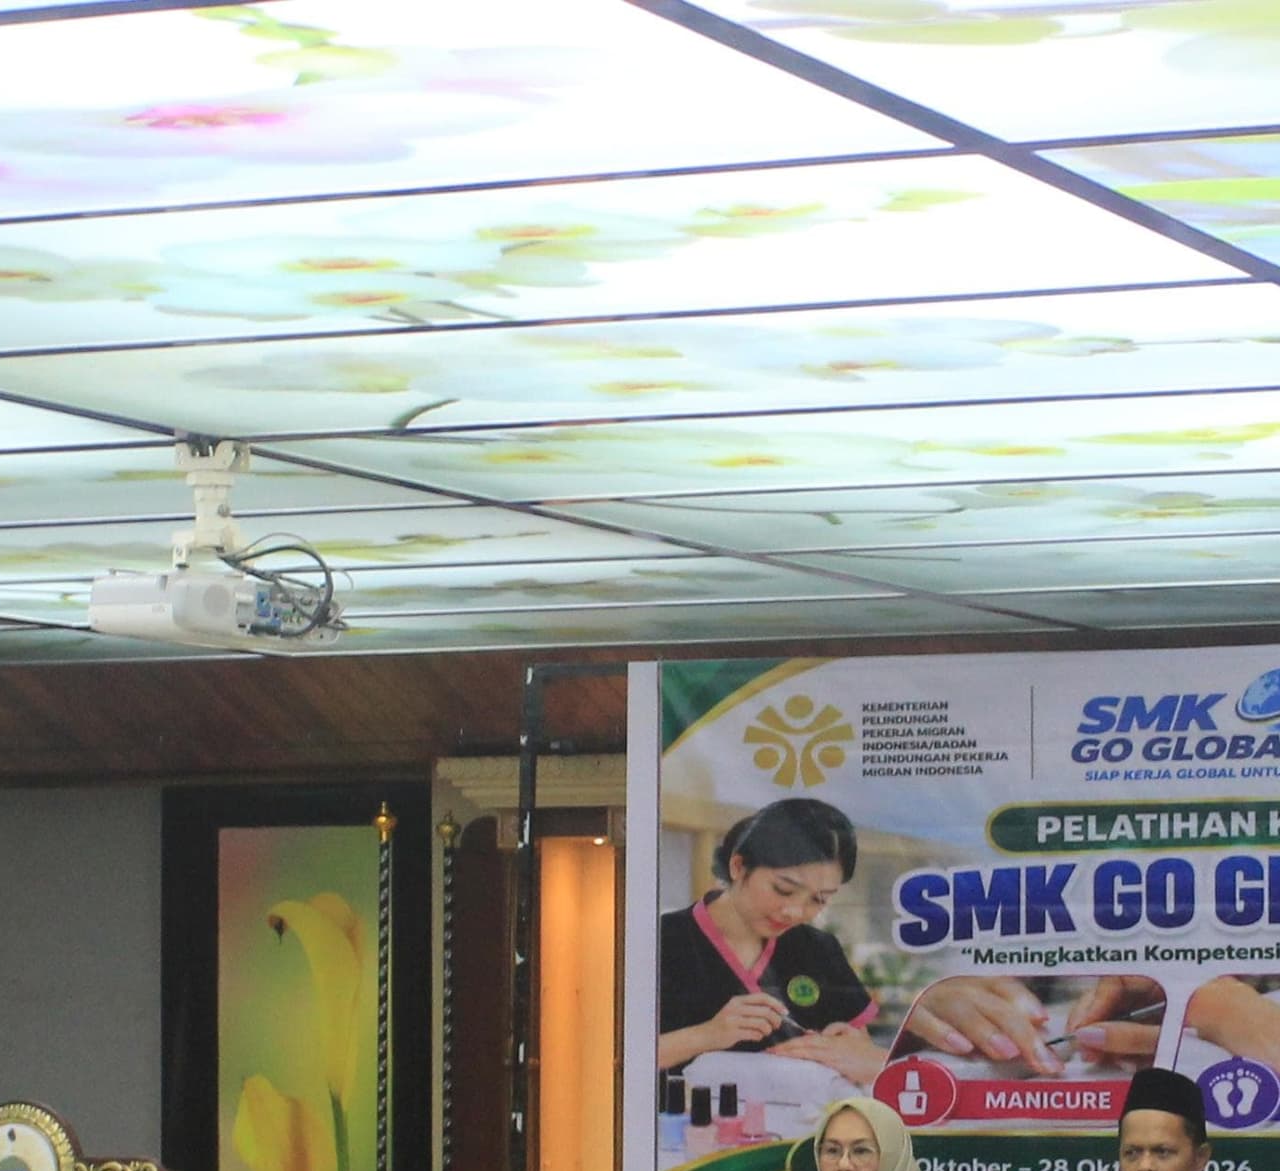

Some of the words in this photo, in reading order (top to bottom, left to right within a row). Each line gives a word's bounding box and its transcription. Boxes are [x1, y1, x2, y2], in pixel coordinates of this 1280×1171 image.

[862, 702, 949, 712] KEMENTERIAN
[1077, 693, 1227, 734] SMK
[862, 714, 948, 725] PELINDUNGAN
[862, 728, 914, 738] PEKERJA
[917, 727, 965, 737] MIGRAN
[862, 740, 977, 750] INDONESIA/BADAN
[1071, 737, 1133, 763] GO
[862, 753, 951, 764] PELINDUNGAN
[954, 752, 1009, 762] PEKERJA
[862, 766, 913, 777] MIGRAN
[915, 765, 984, 776] INDONESIA
[1085, 770, 1120, 781] SIAP
[1124, 769, 1172, 781] KERJA
[1176, 767, 1237, 779] GLOBAL
[1037, 810, 1257, 844] PELATIHAN
[898, 863, 1077, 948] SMK
[1093, 857, 1195, 931] GO
[985, 1091, 1112, 1111] MANICURE
